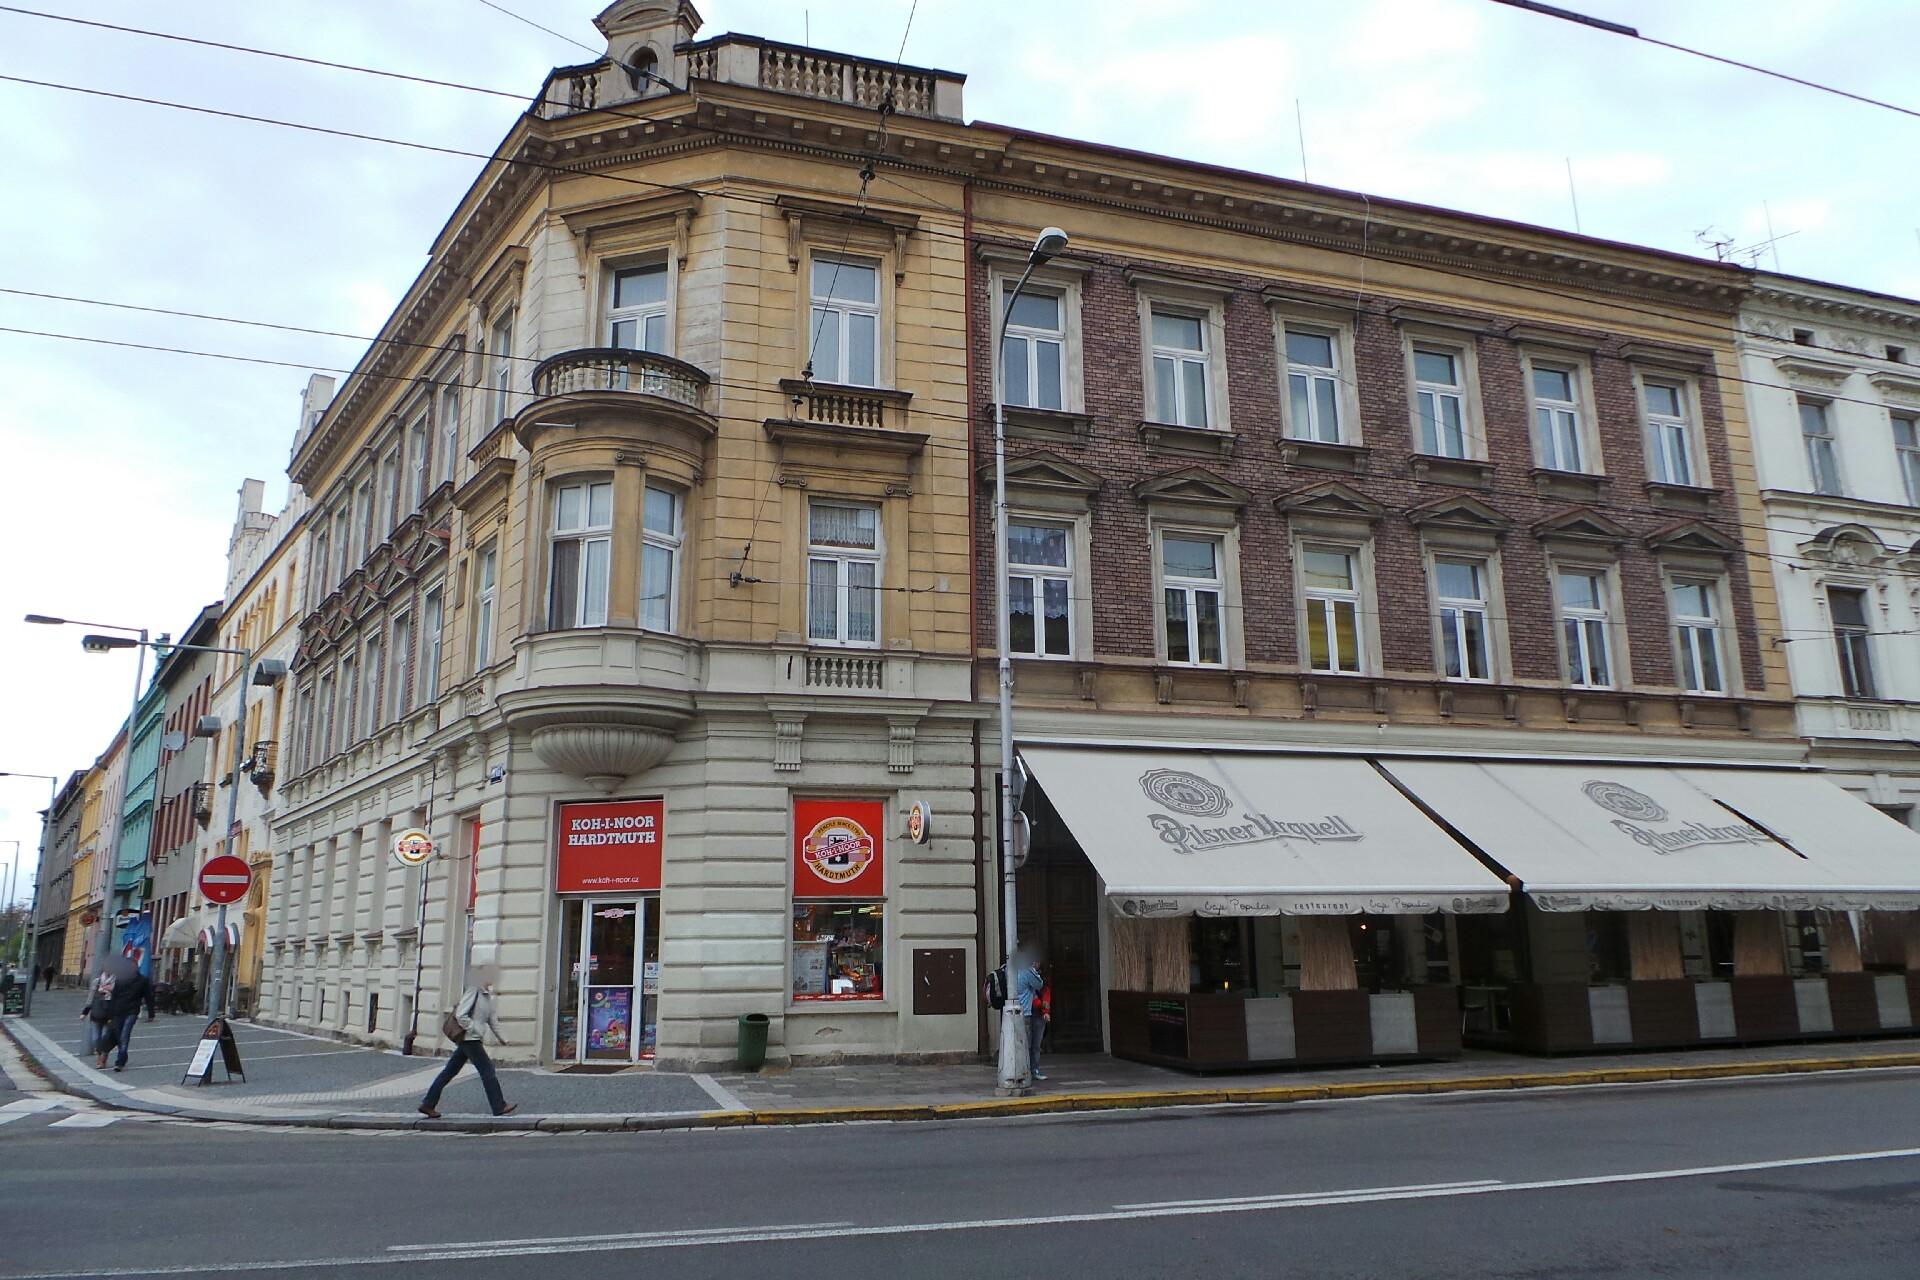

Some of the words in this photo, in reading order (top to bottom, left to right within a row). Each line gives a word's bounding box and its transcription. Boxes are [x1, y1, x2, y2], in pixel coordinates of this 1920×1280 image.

[571, 815, 655, 831] KOH-I-NOOR
[567, 831, 656, 846] HARDTMUTH
[1147, 814, 1257, 855] Pilsner
[1243, 813, 1359, 845] Urquell
[1610, 819, 1702, 856] Pilsner
[814, 863, 860, 879] HARDTMUTH
